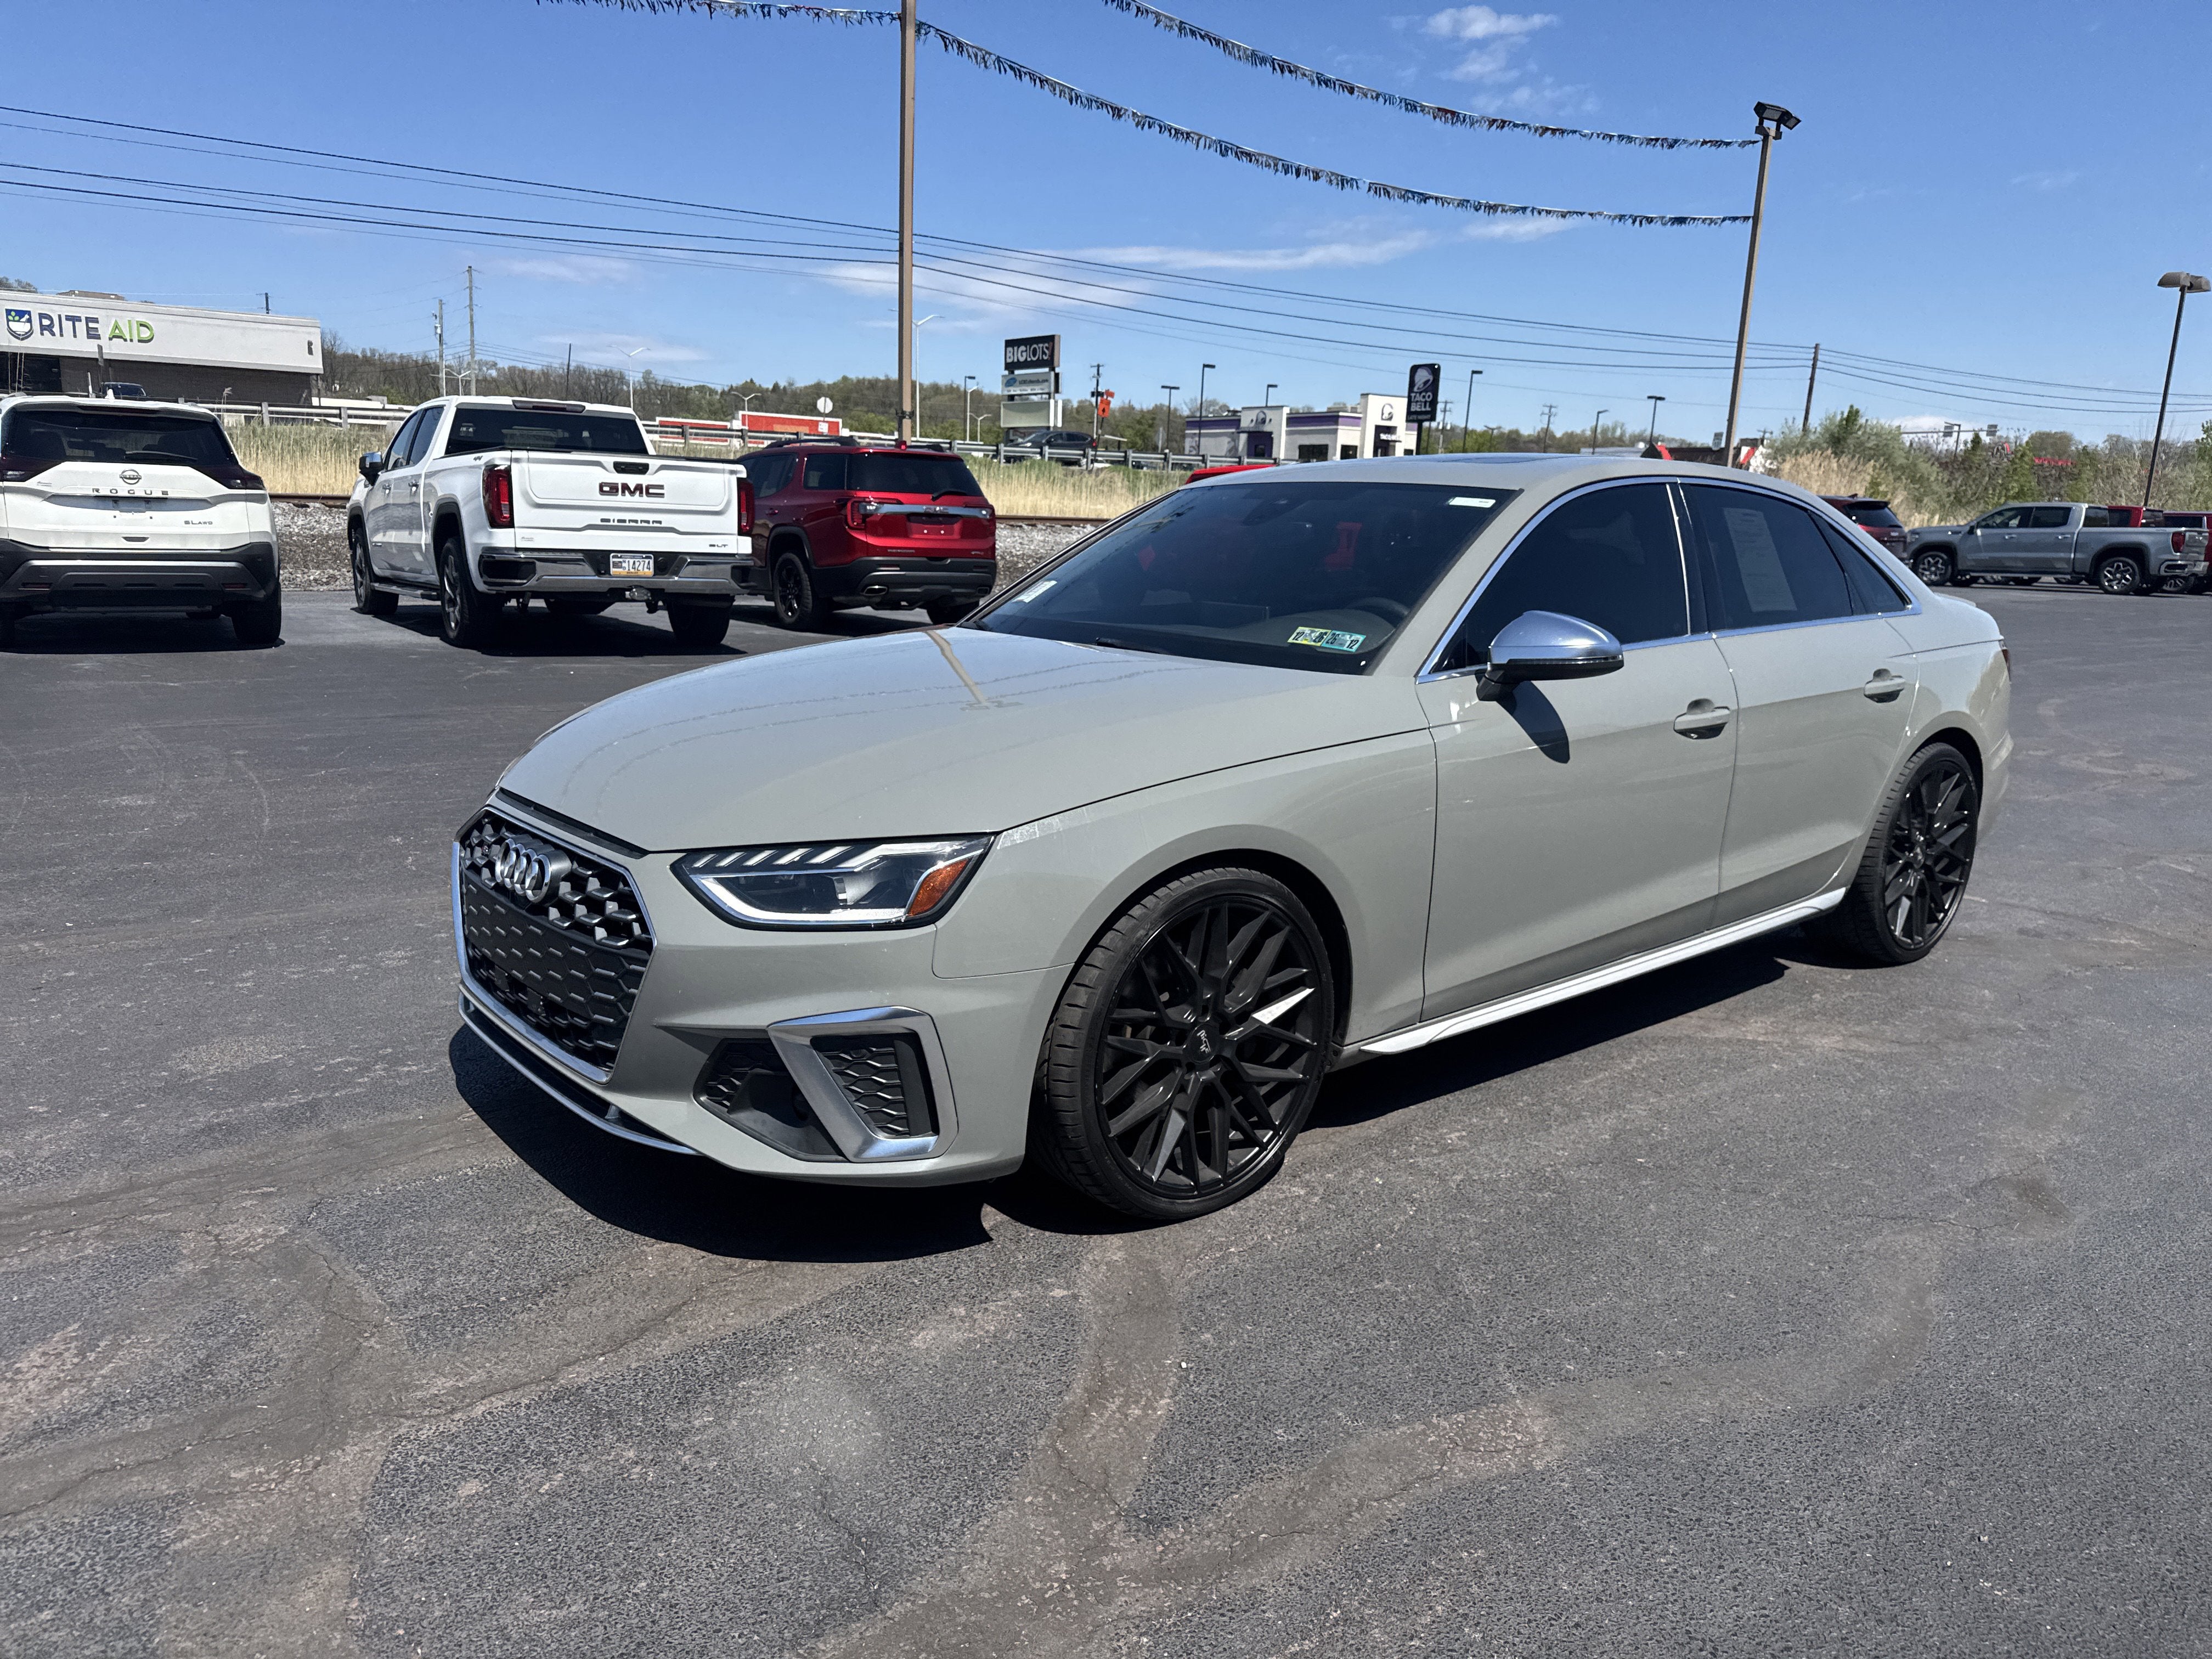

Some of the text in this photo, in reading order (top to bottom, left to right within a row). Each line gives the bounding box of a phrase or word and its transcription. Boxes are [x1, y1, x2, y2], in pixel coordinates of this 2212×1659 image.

[38, 313, 154, 343] RITE AID
[1410, 392, 1432, 402] TACO
[1410, 402, 1431, 411] BELL
[599, 482, 665, 498] GMC
[1346, 639, 1359, 650] 12
